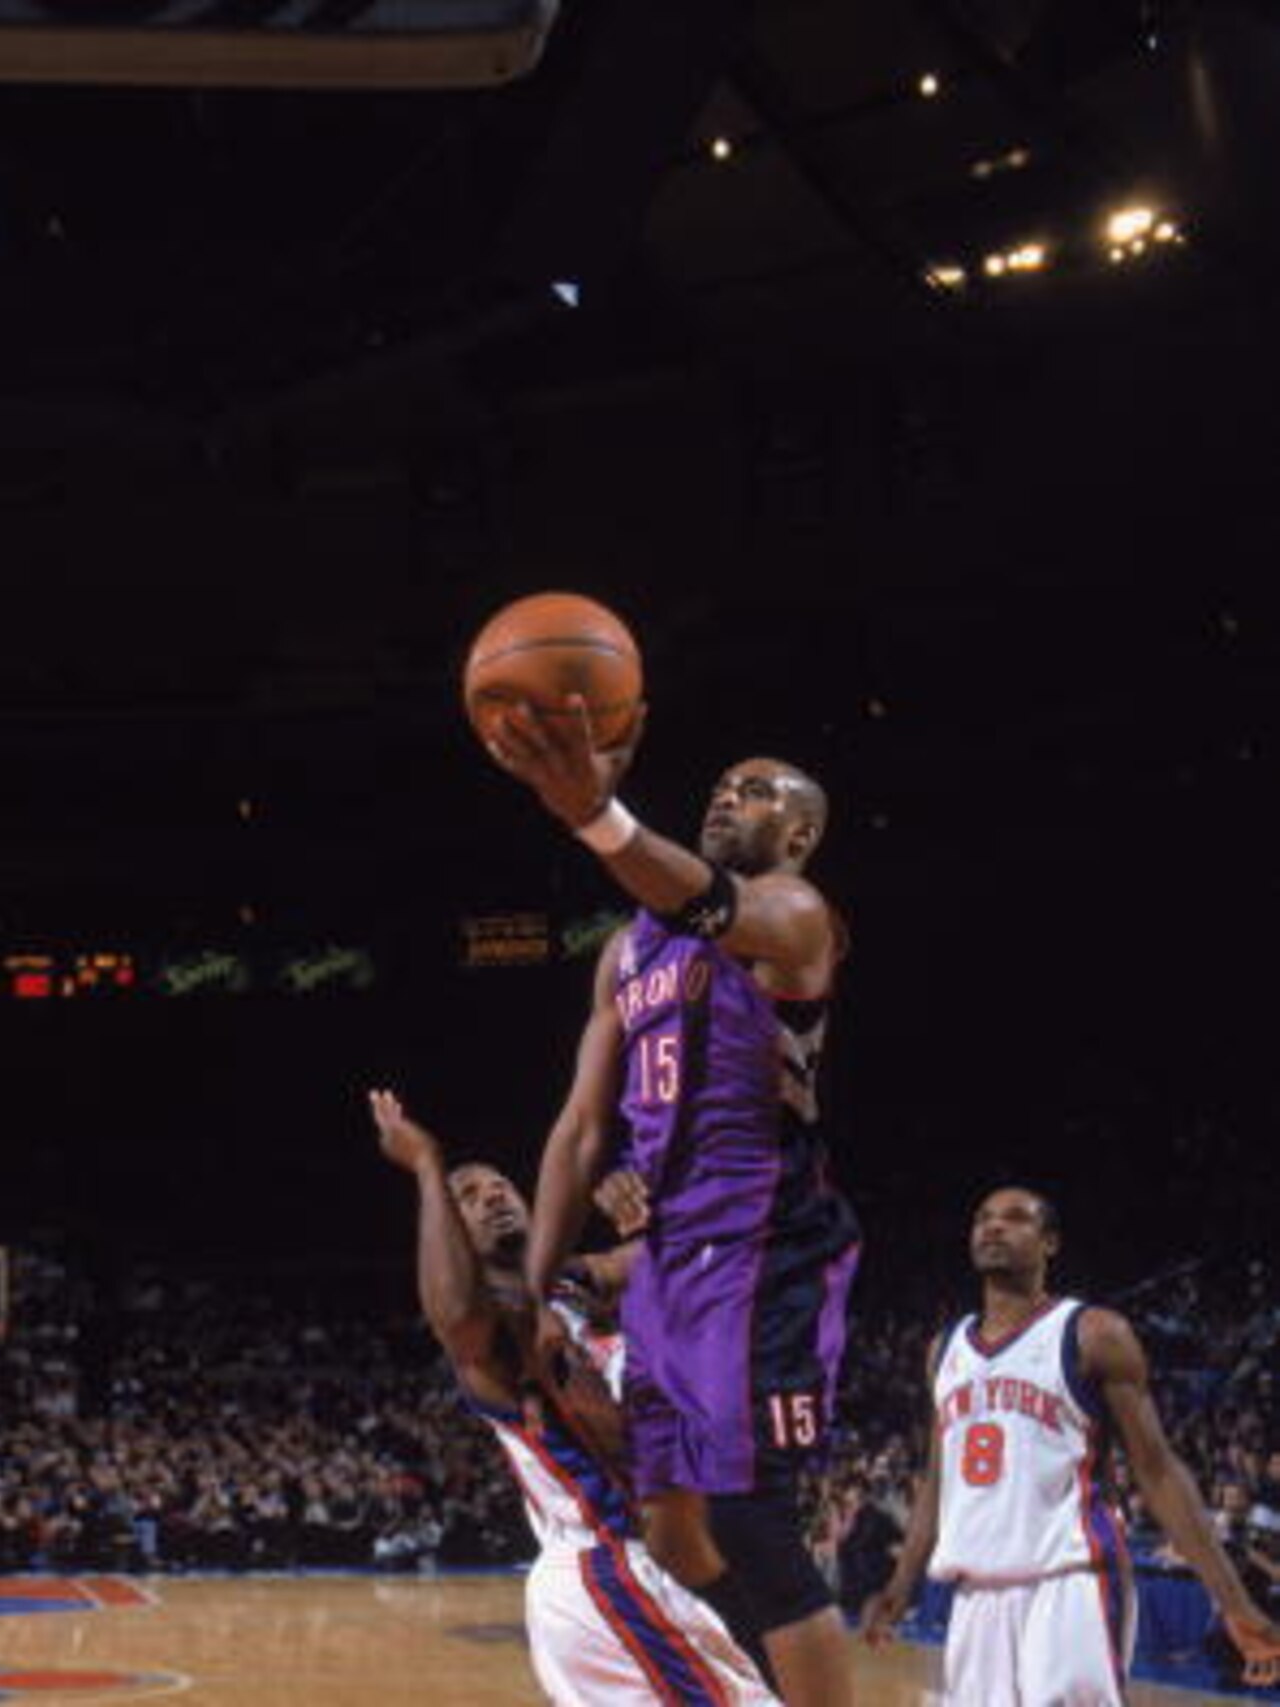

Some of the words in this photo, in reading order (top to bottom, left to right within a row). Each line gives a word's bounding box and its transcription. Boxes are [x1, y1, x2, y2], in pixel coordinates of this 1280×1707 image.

[638, 1035, 680, 1103] 15
[768, 1393, 817, 1449] 15
[960, 1422, 1006, 1487] 8
